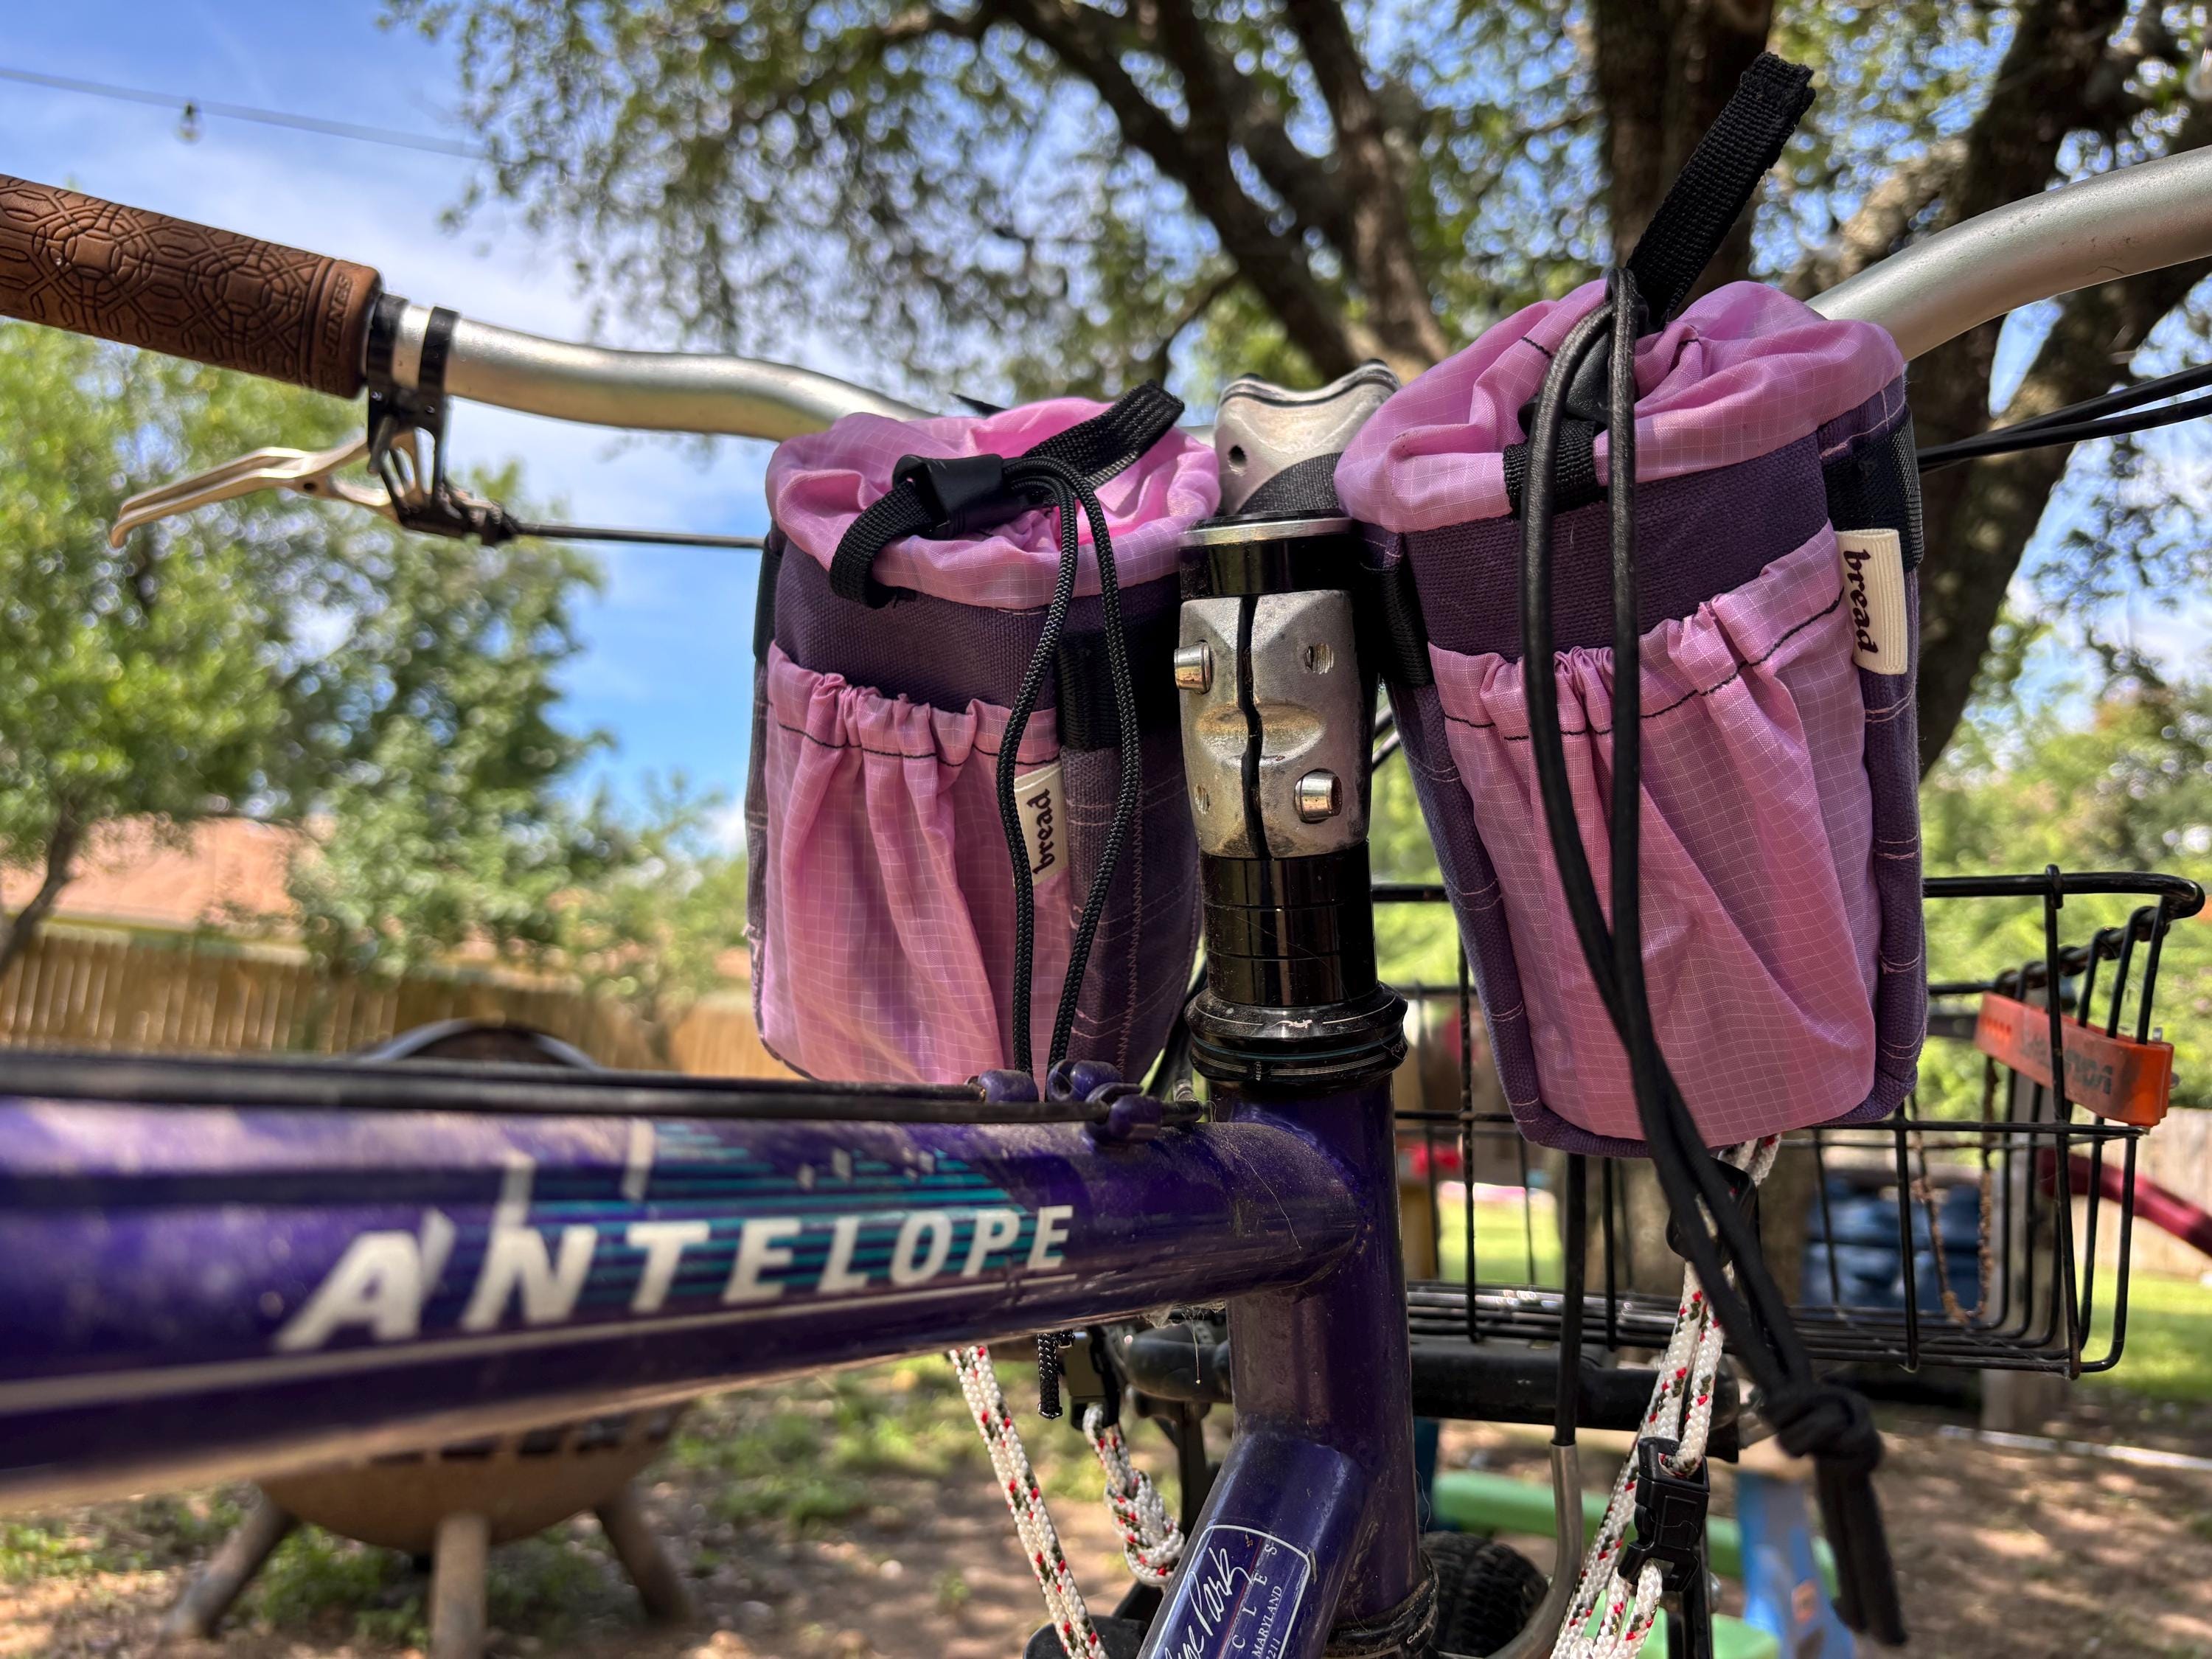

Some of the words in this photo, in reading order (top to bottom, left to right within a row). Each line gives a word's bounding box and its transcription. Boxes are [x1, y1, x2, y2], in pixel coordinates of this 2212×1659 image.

[322, 274, 352, 358] JONES
[1843, 549, 1879, 654] bread
[1026, 788, 1055, 874] bread
[273, 1205, 1074, 1352] ANTELOPE
[1252, 1585, 1283, 1658] MARYLAND
